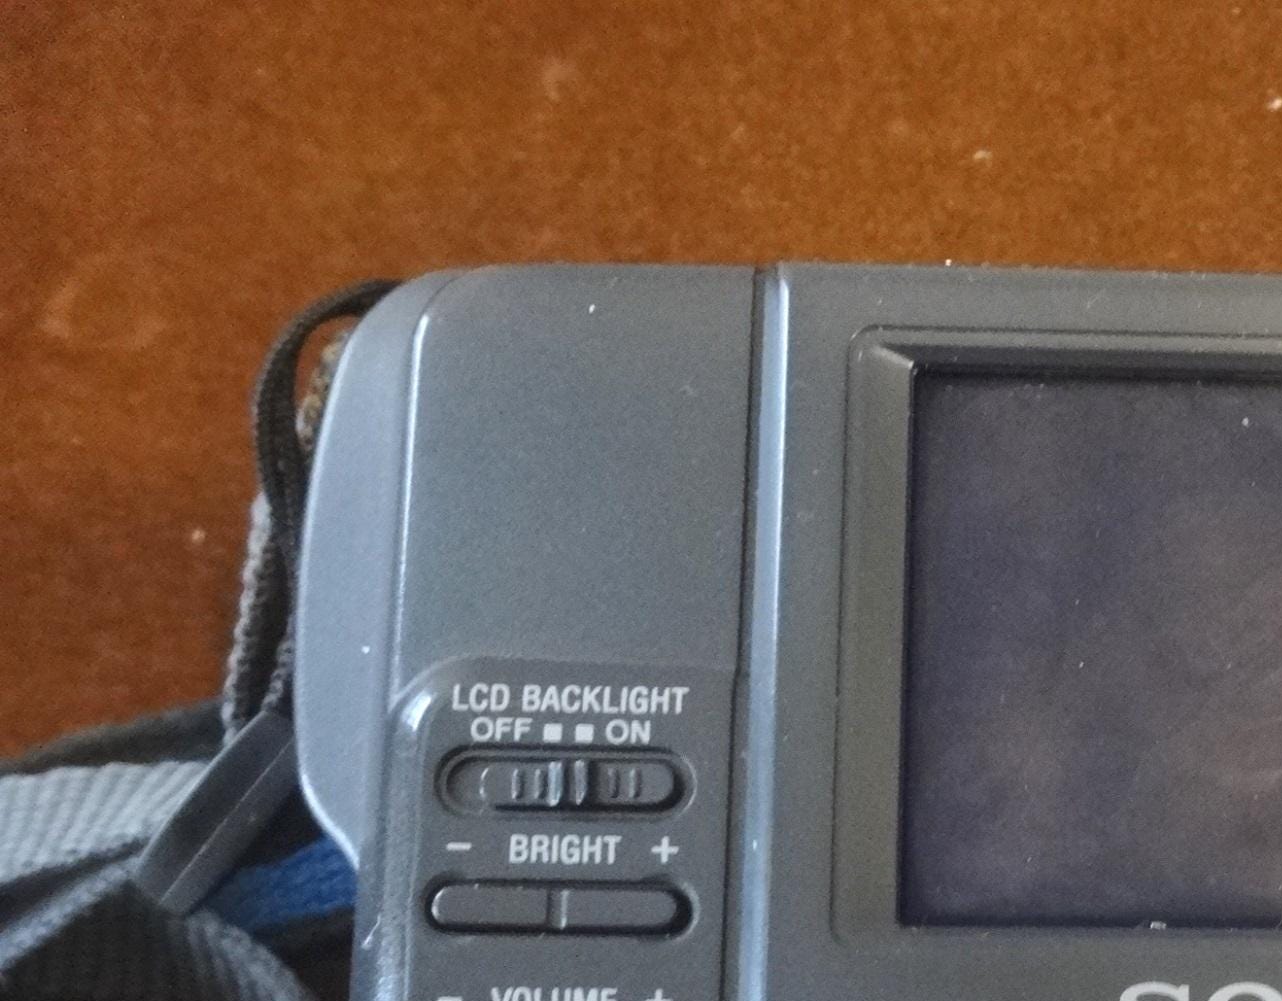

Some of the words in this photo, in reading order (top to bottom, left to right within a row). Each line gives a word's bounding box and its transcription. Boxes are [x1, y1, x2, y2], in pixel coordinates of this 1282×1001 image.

[452, 683, 511, 711] LCD
[521, 684, 690, 715] BACKLIGHT
[470, 716, 534, 743] OFF
[605, 719, 651, 744] ON
[508, 834, 622, 865] BRIGHT
